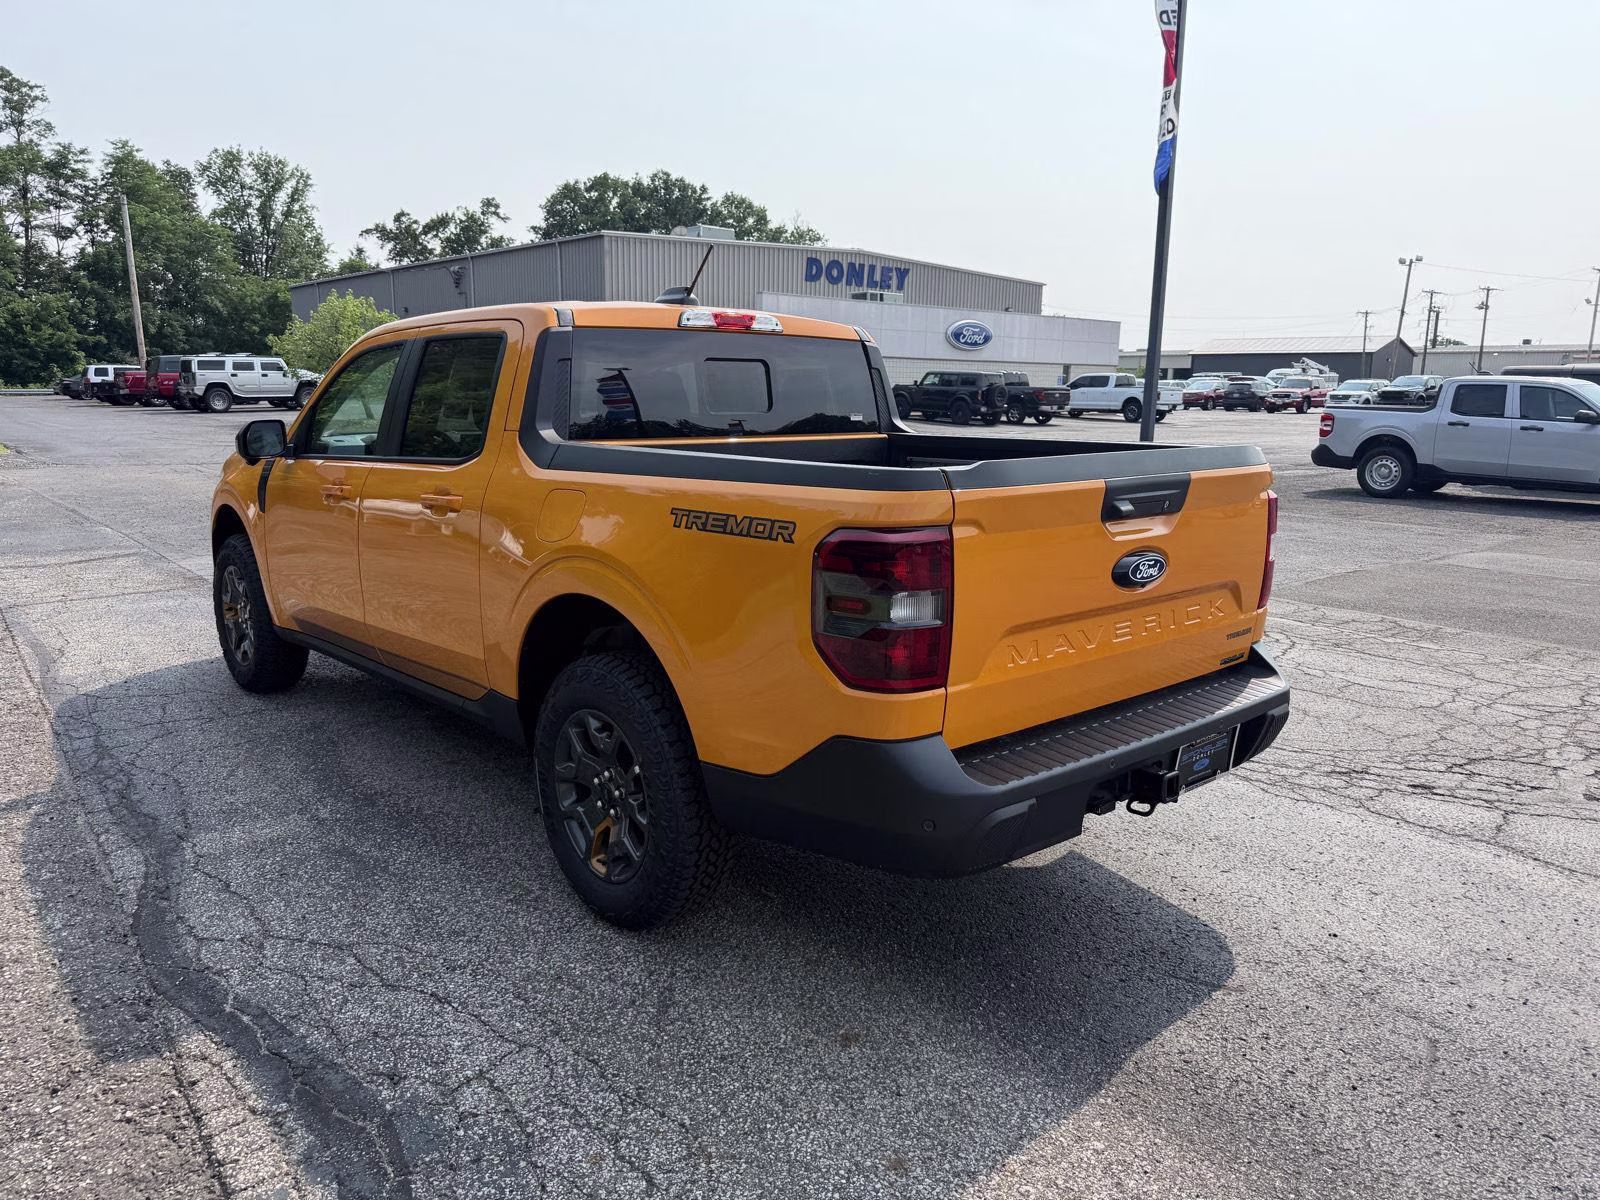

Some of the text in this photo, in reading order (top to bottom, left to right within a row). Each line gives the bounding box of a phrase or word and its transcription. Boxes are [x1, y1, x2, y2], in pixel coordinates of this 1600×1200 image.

[805, 257, 910, 291] DONLEY
[960, 327, 986, 343] Ford
[670, 507, 796, 544] TREMOR
[1136, 560, 1160, 579] Ford
[1007, 598, 1225, 668] MAVERICK
